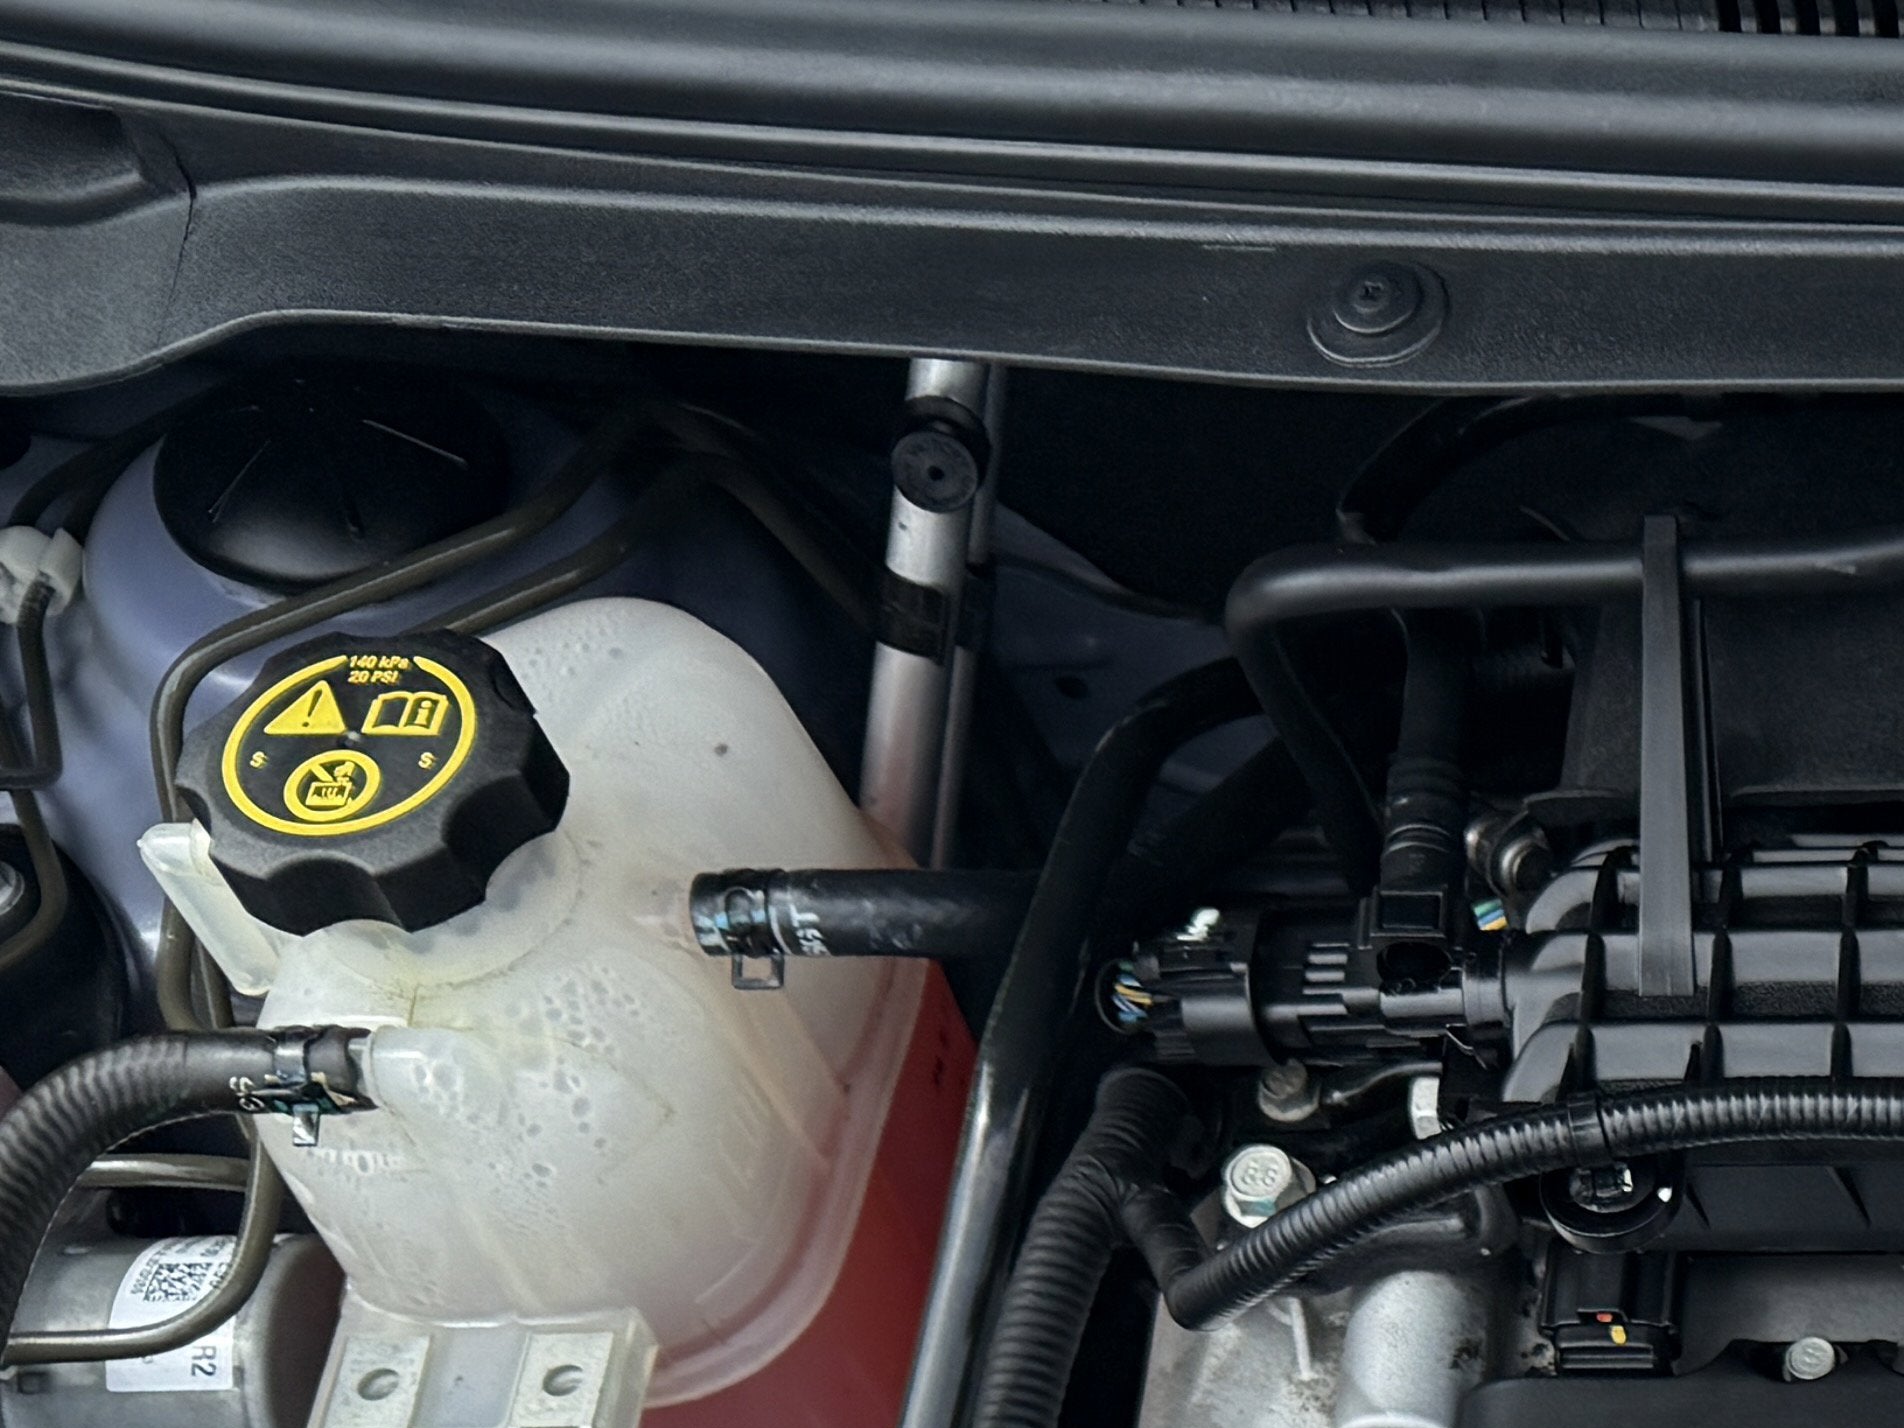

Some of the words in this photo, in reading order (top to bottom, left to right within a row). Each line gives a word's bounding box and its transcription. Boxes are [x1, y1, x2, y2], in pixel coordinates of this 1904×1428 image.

[349, 655, 378, 669] 140
[379, 655, 410, 671] kPa
[347, 670, 370, 684] 20
[370, 670, 399, 685] PSI
